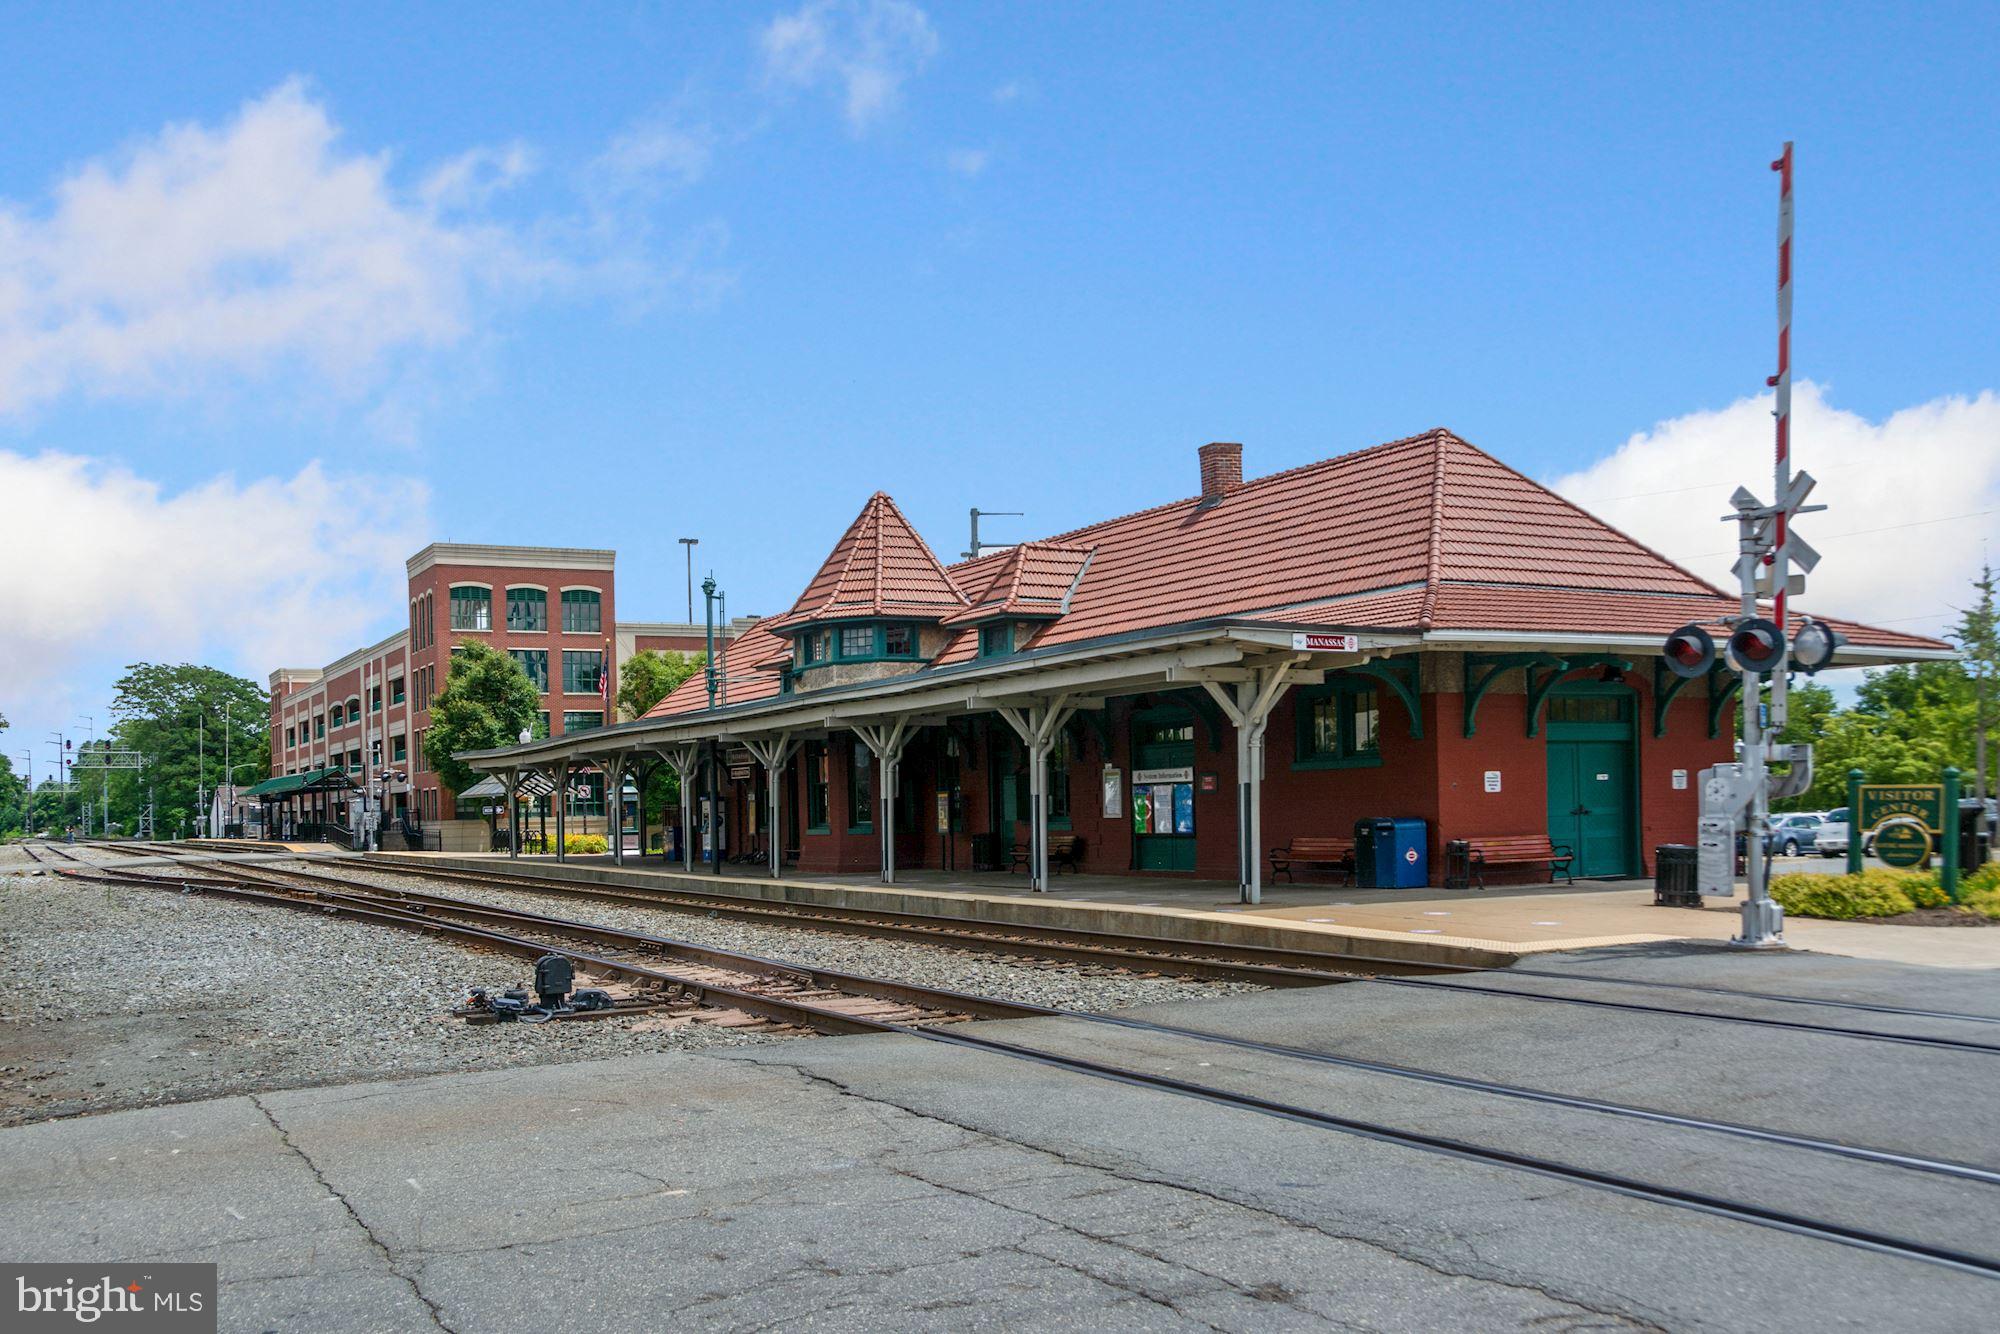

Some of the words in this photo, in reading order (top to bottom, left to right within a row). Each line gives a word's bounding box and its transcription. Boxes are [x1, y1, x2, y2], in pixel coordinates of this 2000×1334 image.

[1306, 637, 1345, 648] MANASSAS
[1158, 771, 1184, 779] Information
[1868, 790, 1935, 801] VISITOR
[1871, 803, 1929, 819] CENTER
